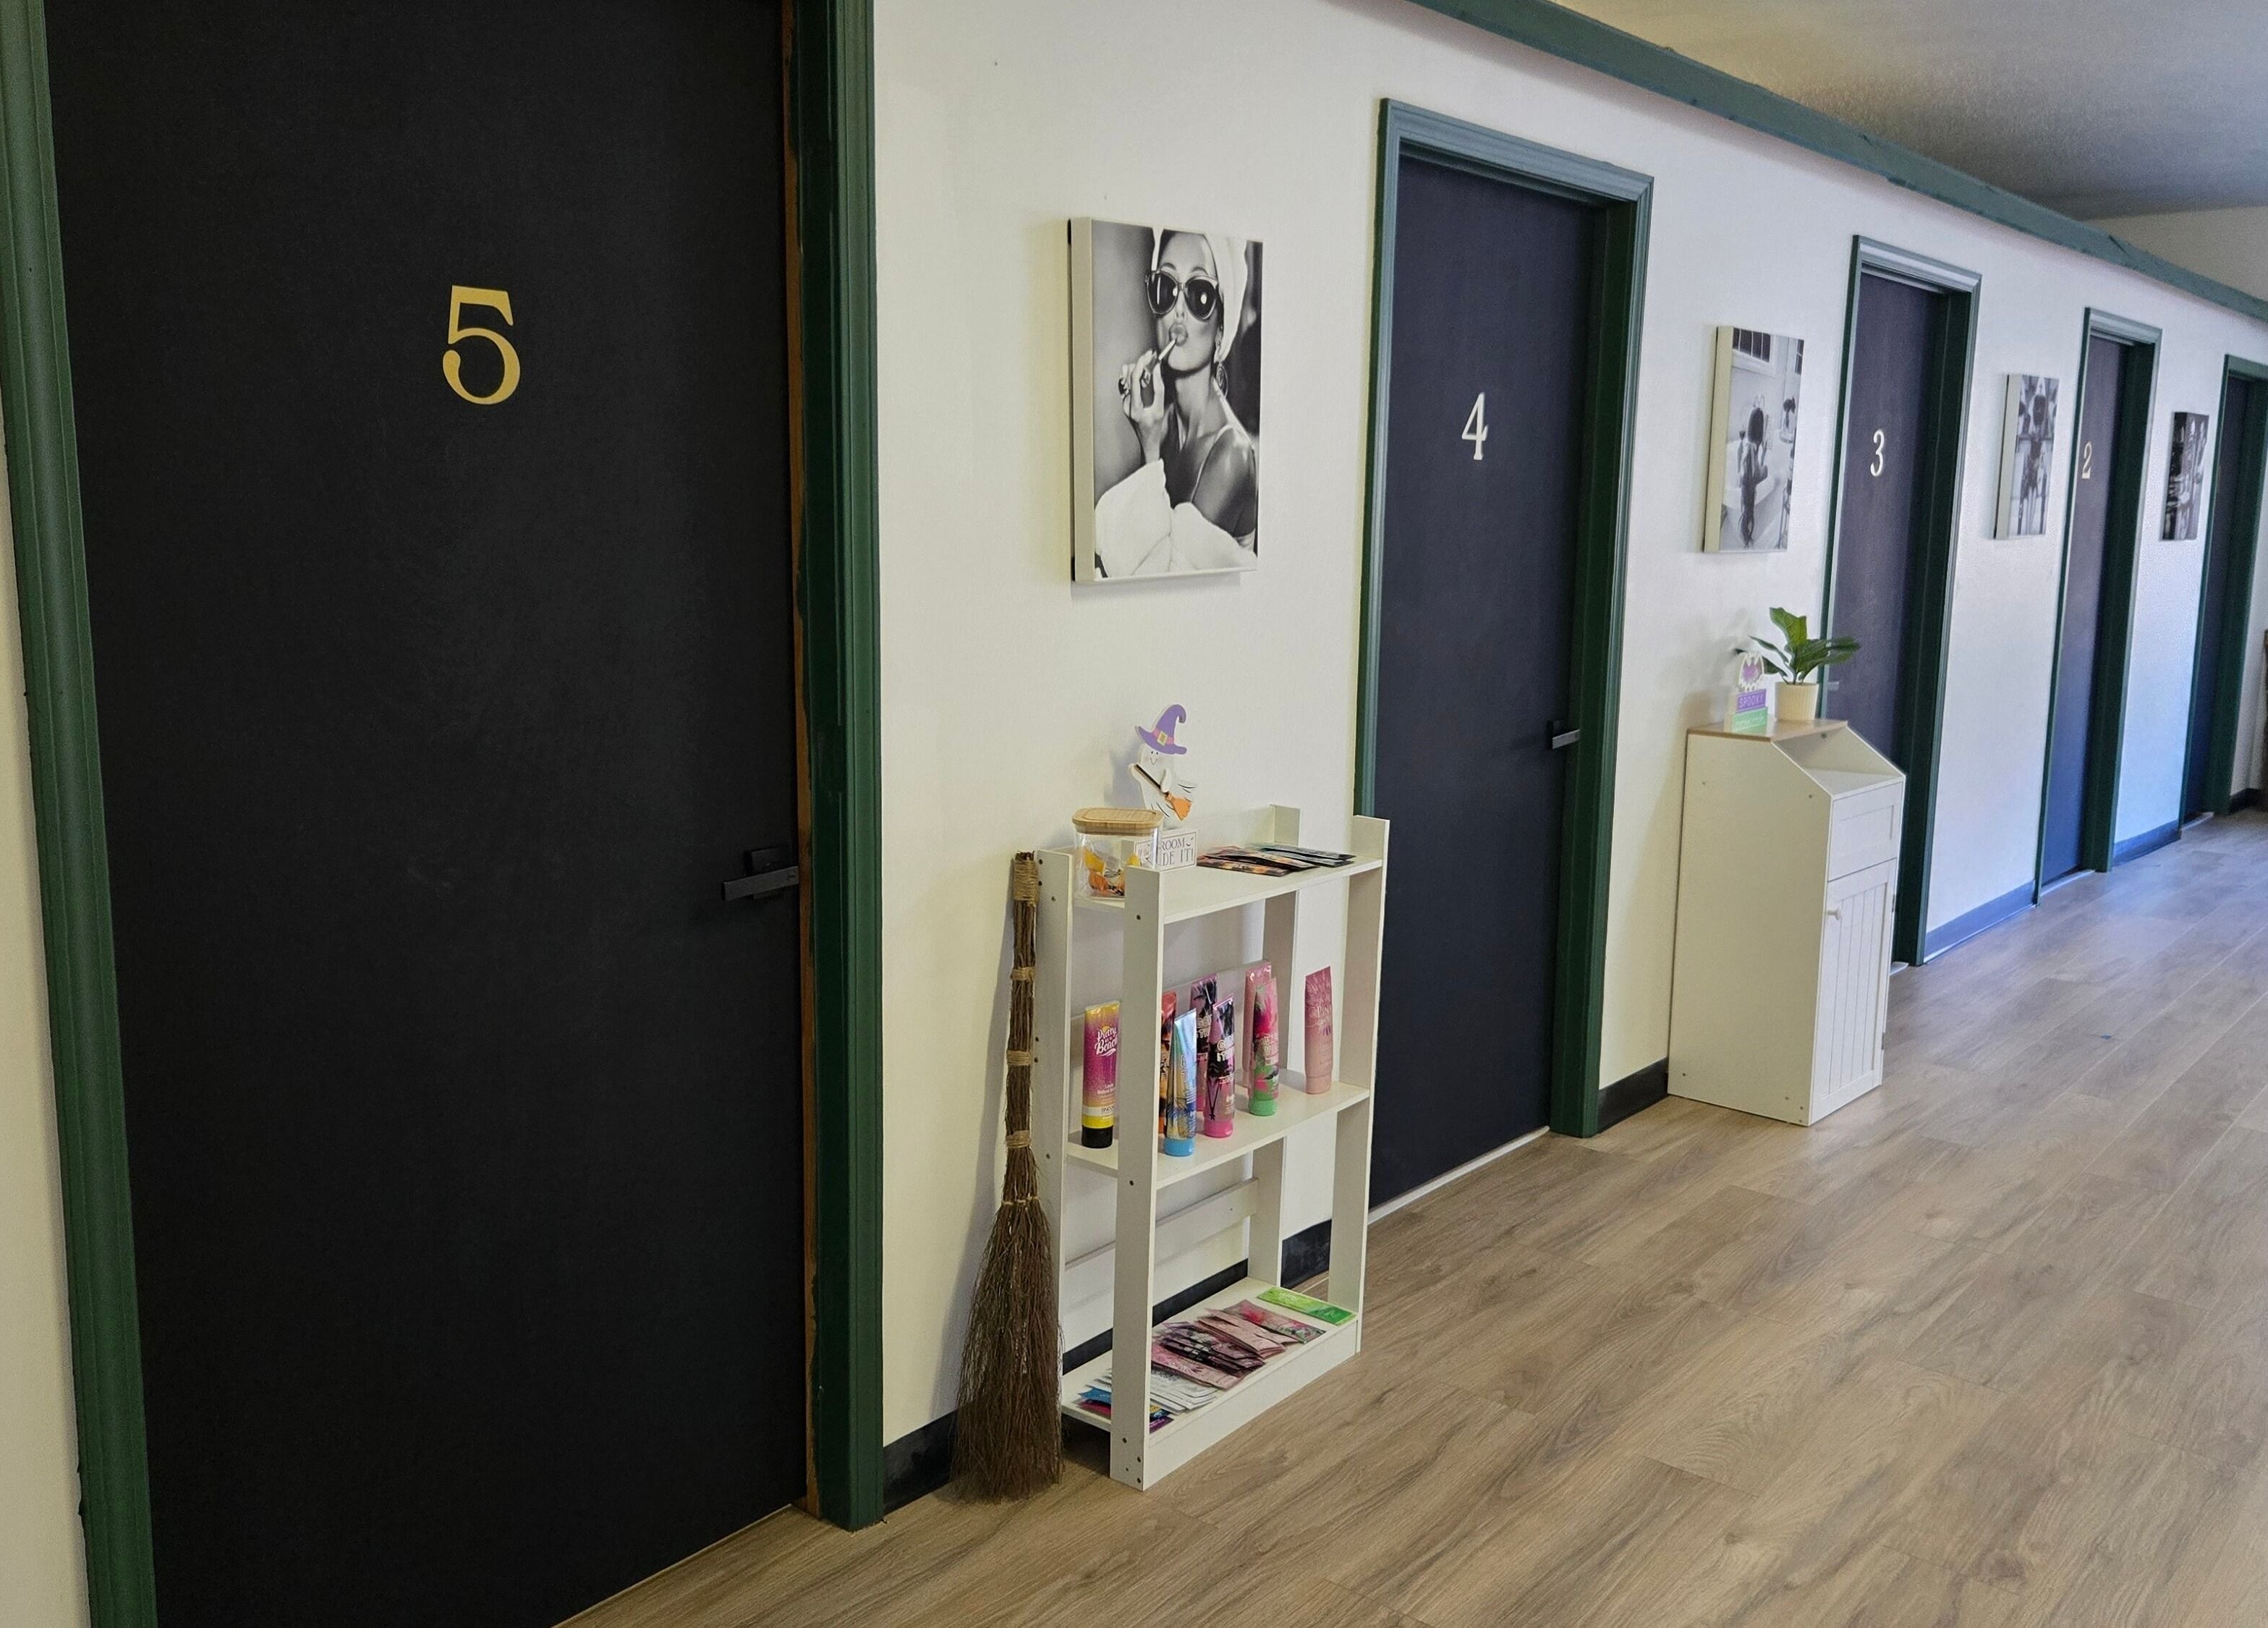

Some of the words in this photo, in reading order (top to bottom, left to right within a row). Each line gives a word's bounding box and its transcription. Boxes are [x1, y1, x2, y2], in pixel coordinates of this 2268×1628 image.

[442, 285, 521, 405] 5
[1461, 391, 1489, 460] 4
[1870, 428, 1885, 477] 3
[2082, 441, 2092, 479] 2
[1158, 837, 1185, 852] ROOM
